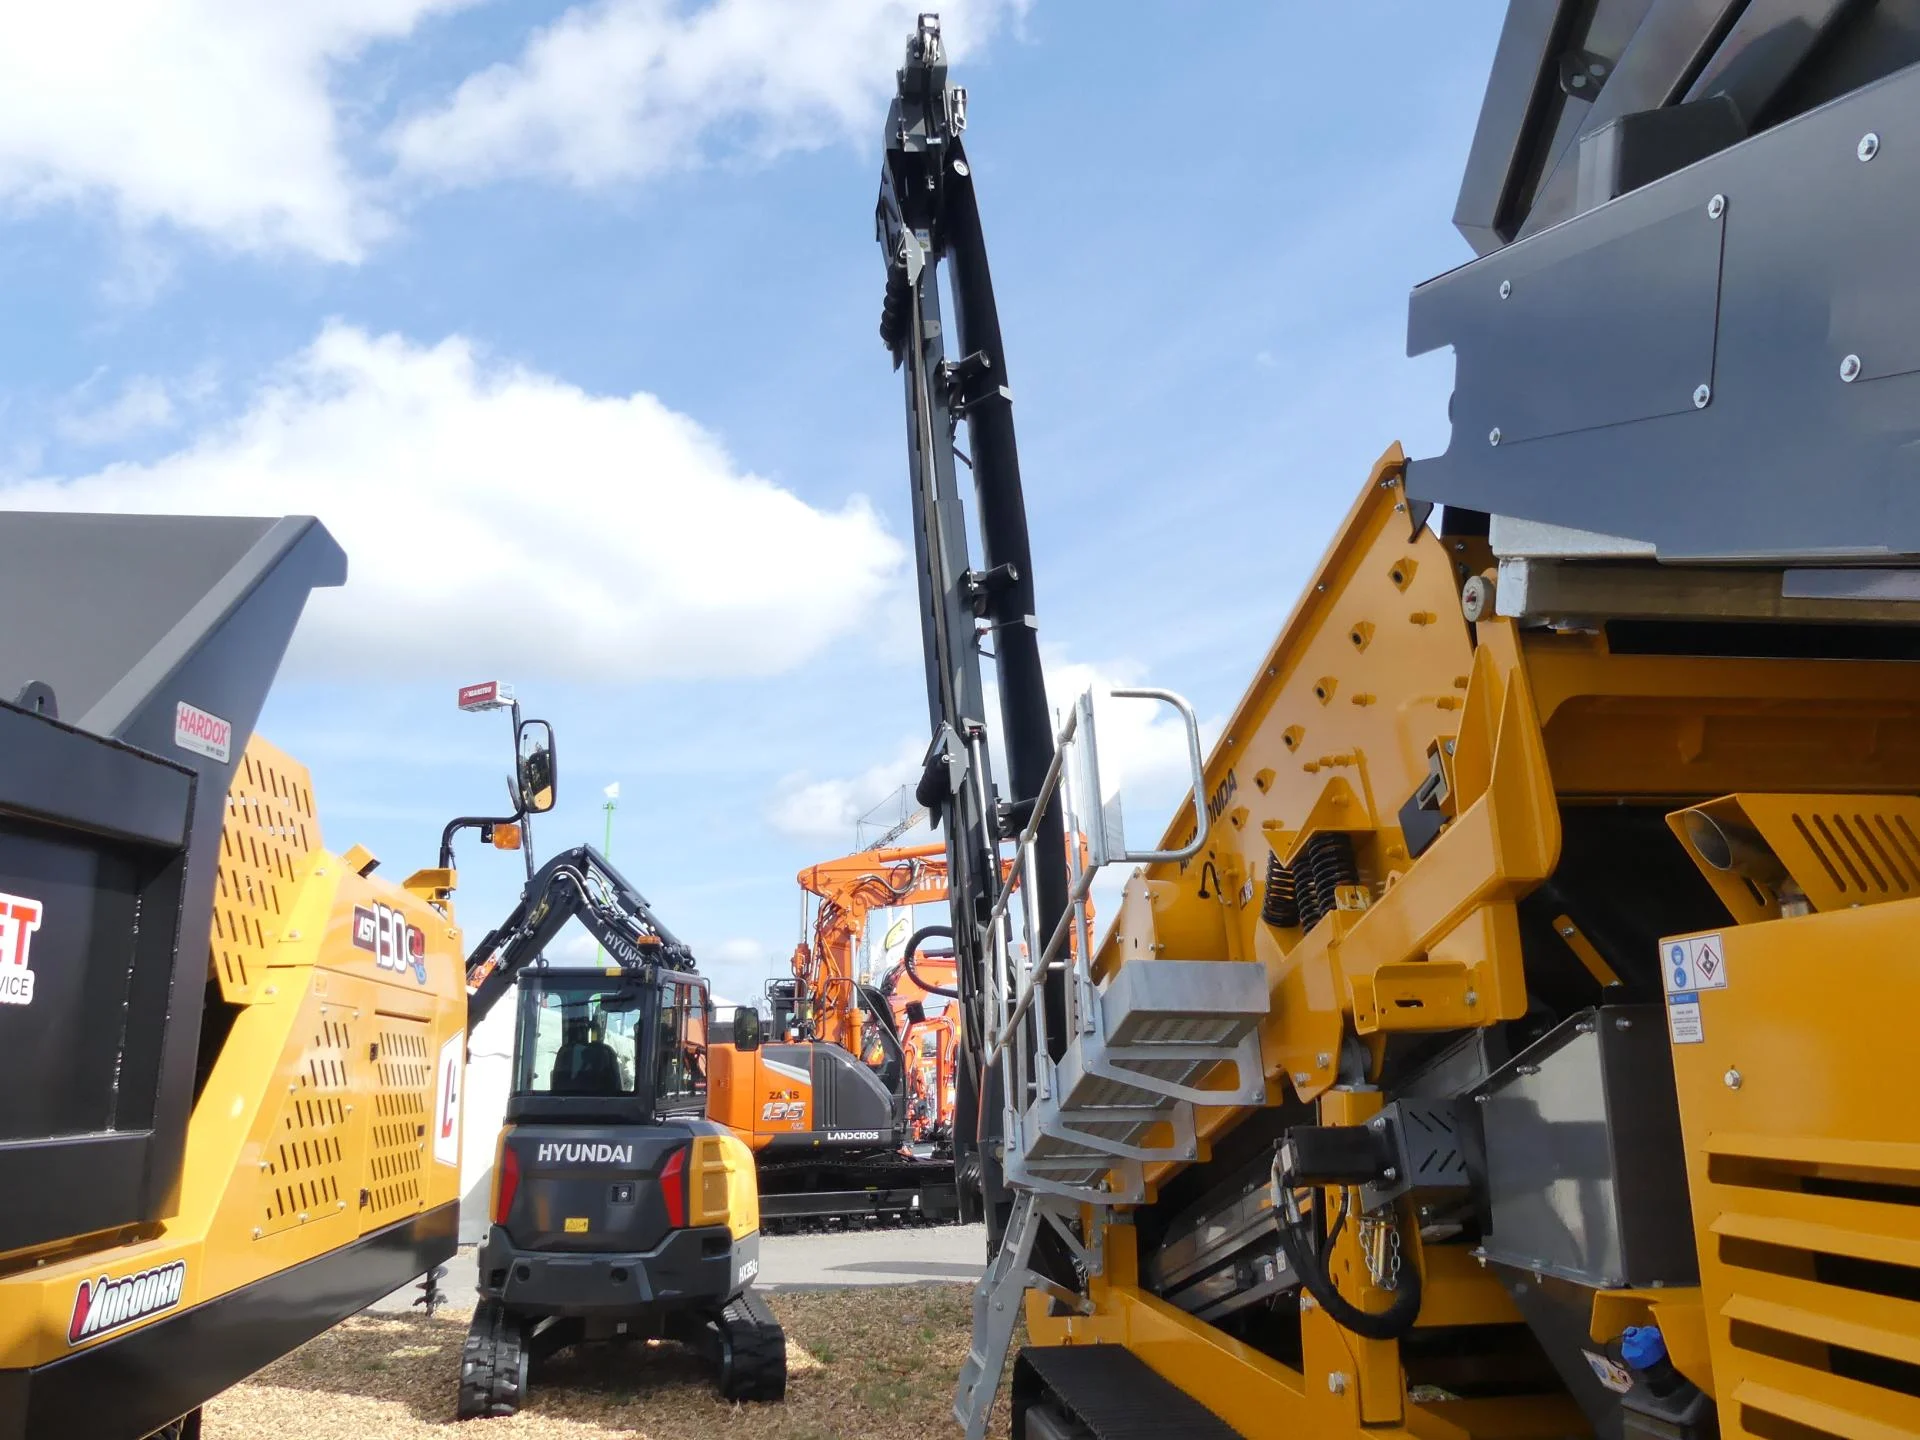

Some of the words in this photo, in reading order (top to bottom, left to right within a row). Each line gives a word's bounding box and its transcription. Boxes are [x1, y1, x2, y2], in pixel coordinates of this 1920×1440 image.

[179, 706, 228, 745] HARDOX
[604, 930, 647, 968] HYUND
[761, 1101, 806, 1121] 135
[827, 1131, 879, 1140] LANDCROS
[538, 1143, 632, 1162] HYUNDAI
[70, 1262, 184, 1340] MOROOKA
